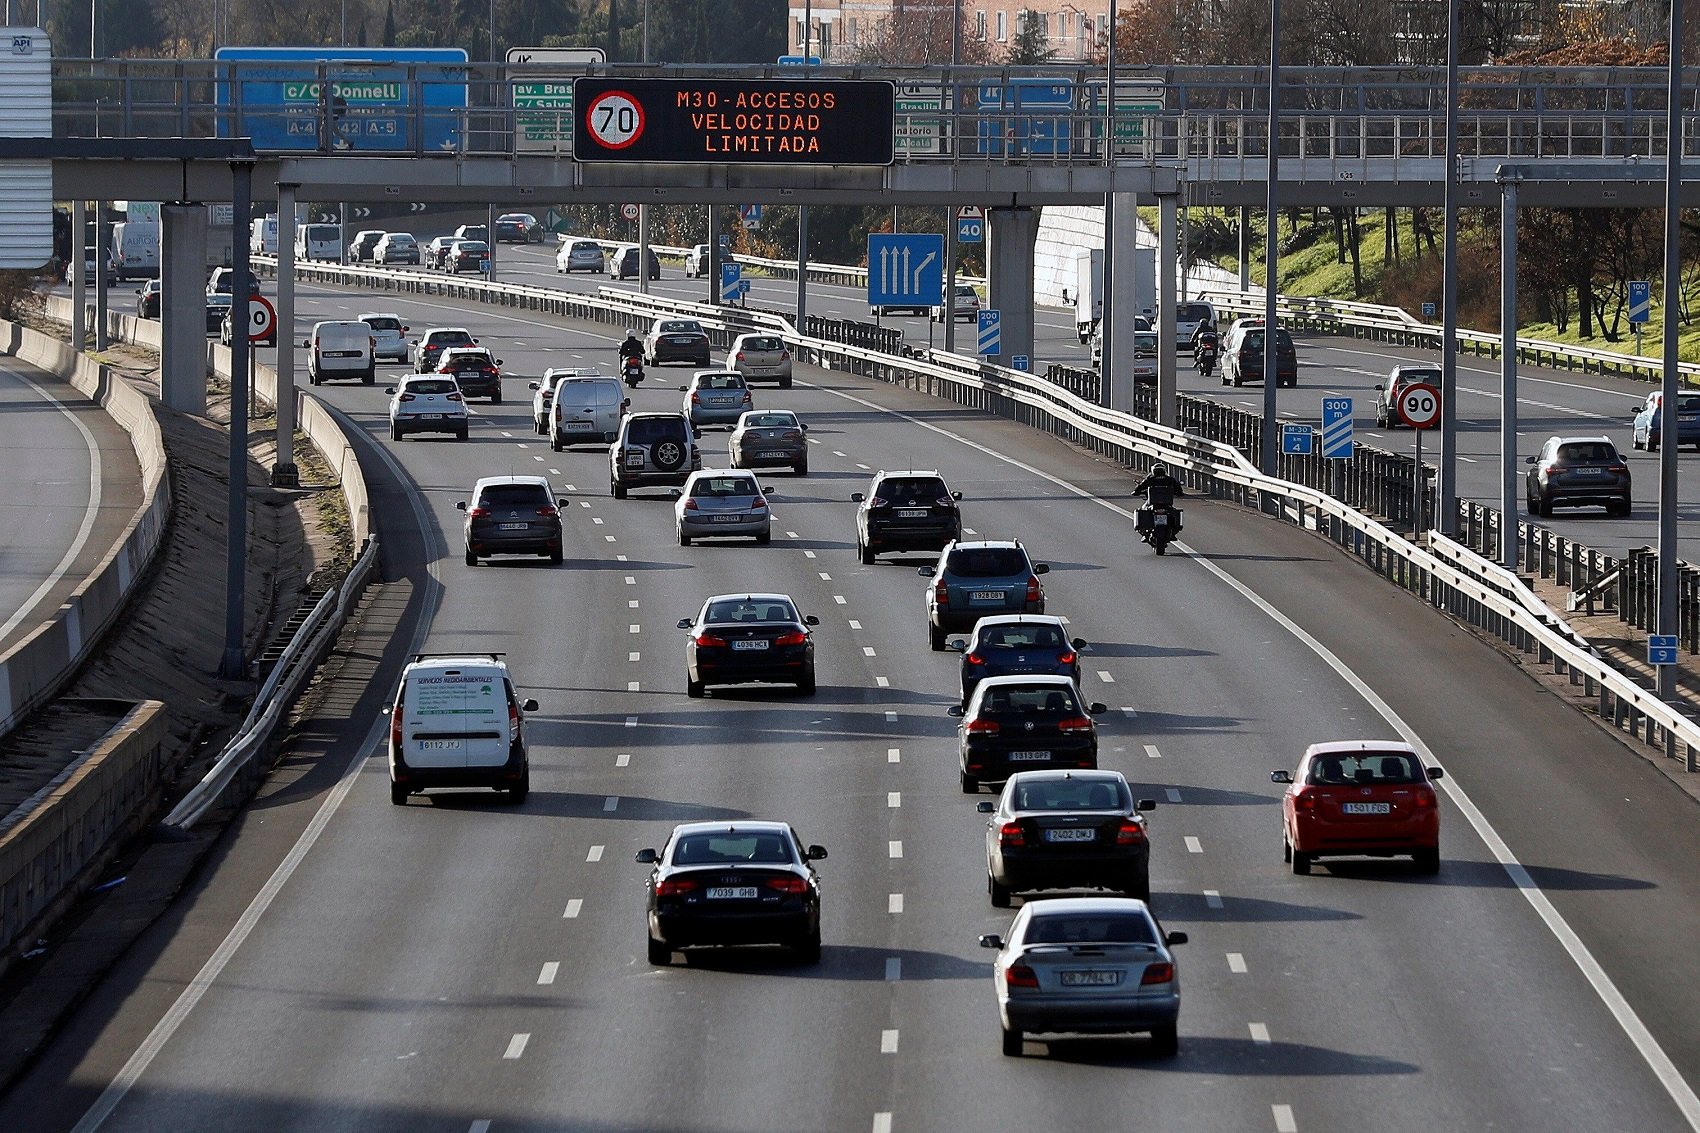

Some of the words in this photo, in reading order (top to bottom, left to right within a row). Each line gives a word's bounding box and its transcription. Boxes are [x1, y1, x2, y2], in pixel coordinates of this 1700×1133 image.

[517, 85, 537, 94] av.
[599, 106, 634, 133] 70
[692, 113, 820, 131] VELOCIDAD
[289, 122, 314, 134] A-4
[368, 122, 395, 134] A-5
[706, 135, 820, 153] LIMITADA
[625, 207, 637, 215] 40
[960, 223, 981, 237] 40
[980, 312, 997, 320] 200
[1326, 401, 1348, 410] 300
[1408, 397, 1433, 412] 90
[1292, 443, 1300, 451] 4
[1660, 637, 1667, 646] 3
[1658, 650, 1668, 661] 9
[424, 741, 444, 749] 6112
[445, 741, 461, 749] JYJ
[1053, 830, 1074, 839] 2402
[713, 888, 734, 897] 7039
